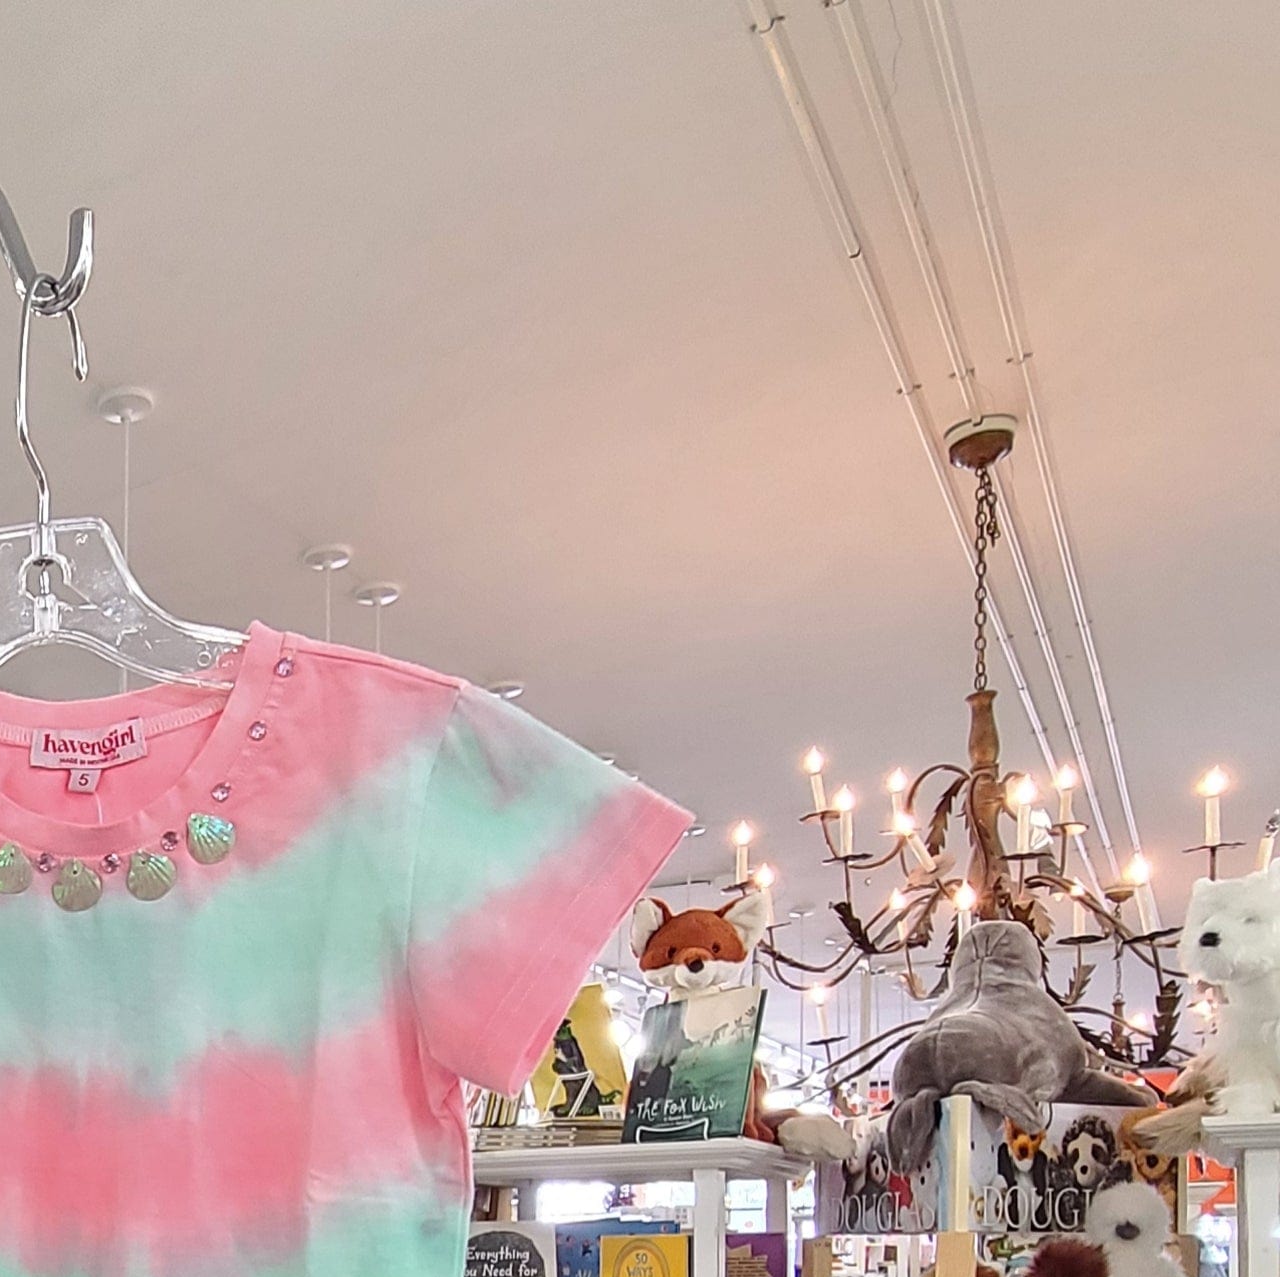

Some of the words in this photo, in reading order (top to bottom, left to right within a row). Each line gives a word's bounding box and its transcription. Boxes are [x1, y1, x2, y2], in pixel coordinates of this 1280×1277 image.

[43, 725, 136, 756] havengirl
[78, 773, 89, 786] 5
[467, 1245, 530, 1263] Everything
[635, 1252, 648, 1264] 50
[482, 1262, 513, 1277] Need
[518, 1263, 538, 1277] for
[626, 1266, 653, 1277] WAYS
